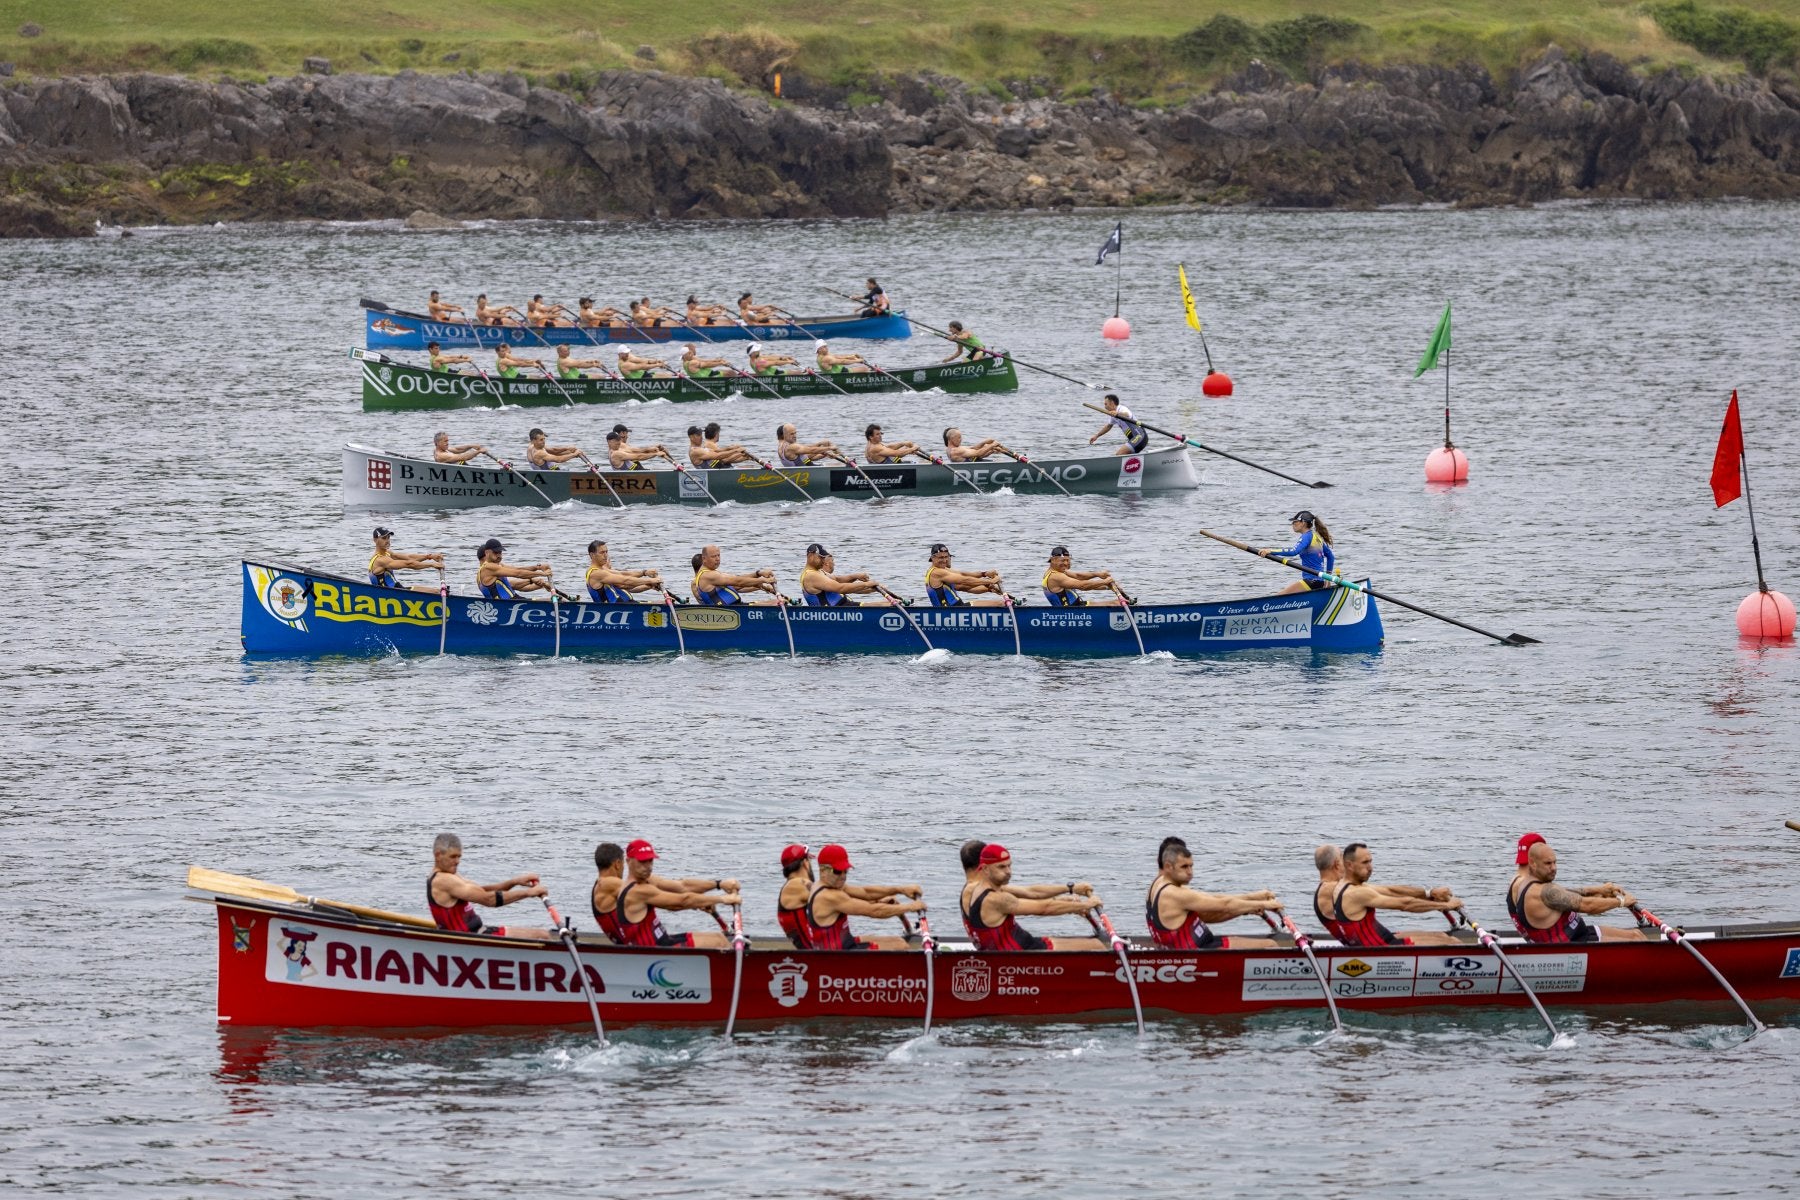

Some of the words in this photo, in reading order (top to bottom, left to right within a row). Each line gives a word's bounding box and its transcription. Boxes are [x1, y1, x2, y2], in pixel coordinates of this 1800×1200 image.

[952, 464, 1087, 486] PEGAMO
[571, 478, 656, 490] TIERRA
[405, 484, 505, 497] ETXEBIZITZAK
[313, 581, 450, 618] Rianxo
[1042, 612, 1092, 620] Parrillada
[1133, 611, 1202, 624] Rianxo
[1231, 616, 1280, 626] XUNTA
[1030, 618, 1093, 627] Ourense
[1229, 626, 1247, 636] DE
[1252, 623, 1309, 635] GALICIA
[326, 941, 607, 994] RIANXEIRA
[998, 966, 1065, 976] CONCELLO
[1343, 964, 1366, 972] AMC
[998, 976, 1015, 985] DE
[632, 988, 660, 1000] we
[665, 988, 701, 1000] sea
[818, 990, 845, 1003] DA
[849, 987, 926, 1003] CORUÑA
[998, 986, 1041, 996] BOIRO
